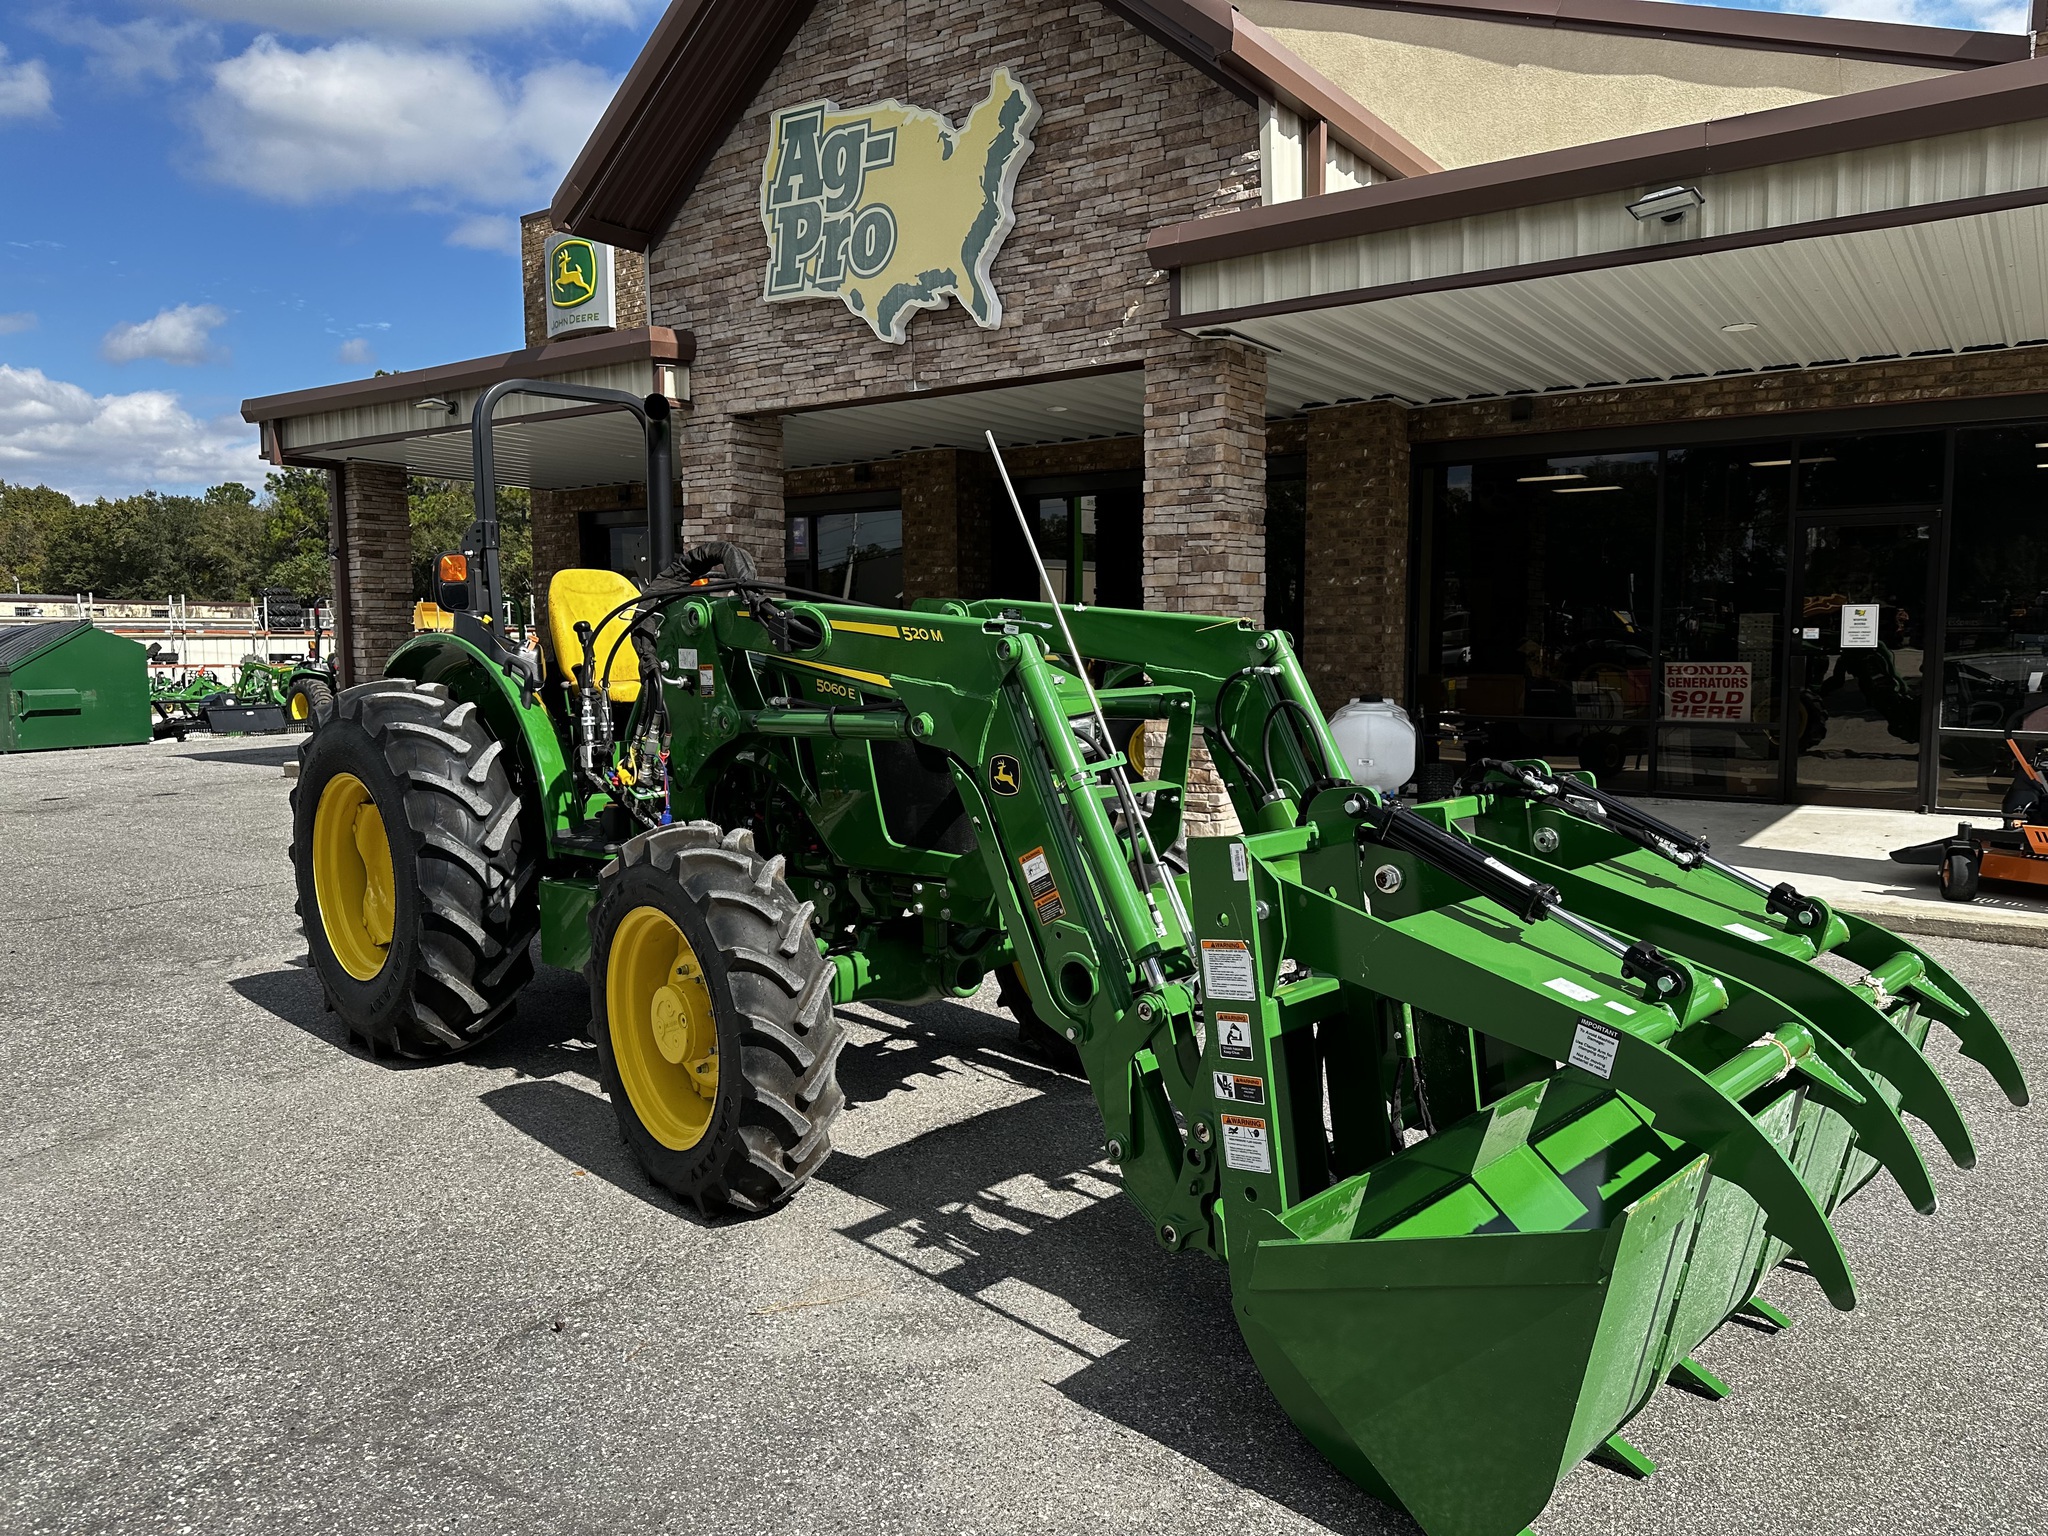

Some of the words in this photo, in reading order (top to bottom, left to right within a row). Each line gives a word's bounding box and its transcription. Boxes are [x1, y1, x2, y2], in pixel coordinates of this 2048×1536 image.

[766, 104, 898, 214] Ag-
[767, 201, 898, 296] Pro
[551, 319, 570, 330] JOHN
[569, 312, 600, 325] DEERE
[901, 626, 929, 642] 520
[931, 629, 944, 643] M
[1666, 665, 1749, 675] HONDA
[816, 678, 847, 697] 5060
[848, 687, 856, 700] E
[1667, 677, 1748, 689] GENERATORS
[1670, 690, 1745, 705] SOLD
[1671, 705, 1743, 719] HERE
[1581, 1018, 1618, 1037] IMPORTANT
[1231, 1117, 1260, 1126] WARNING
[691, 1095, 733, 1182] GALAXY
